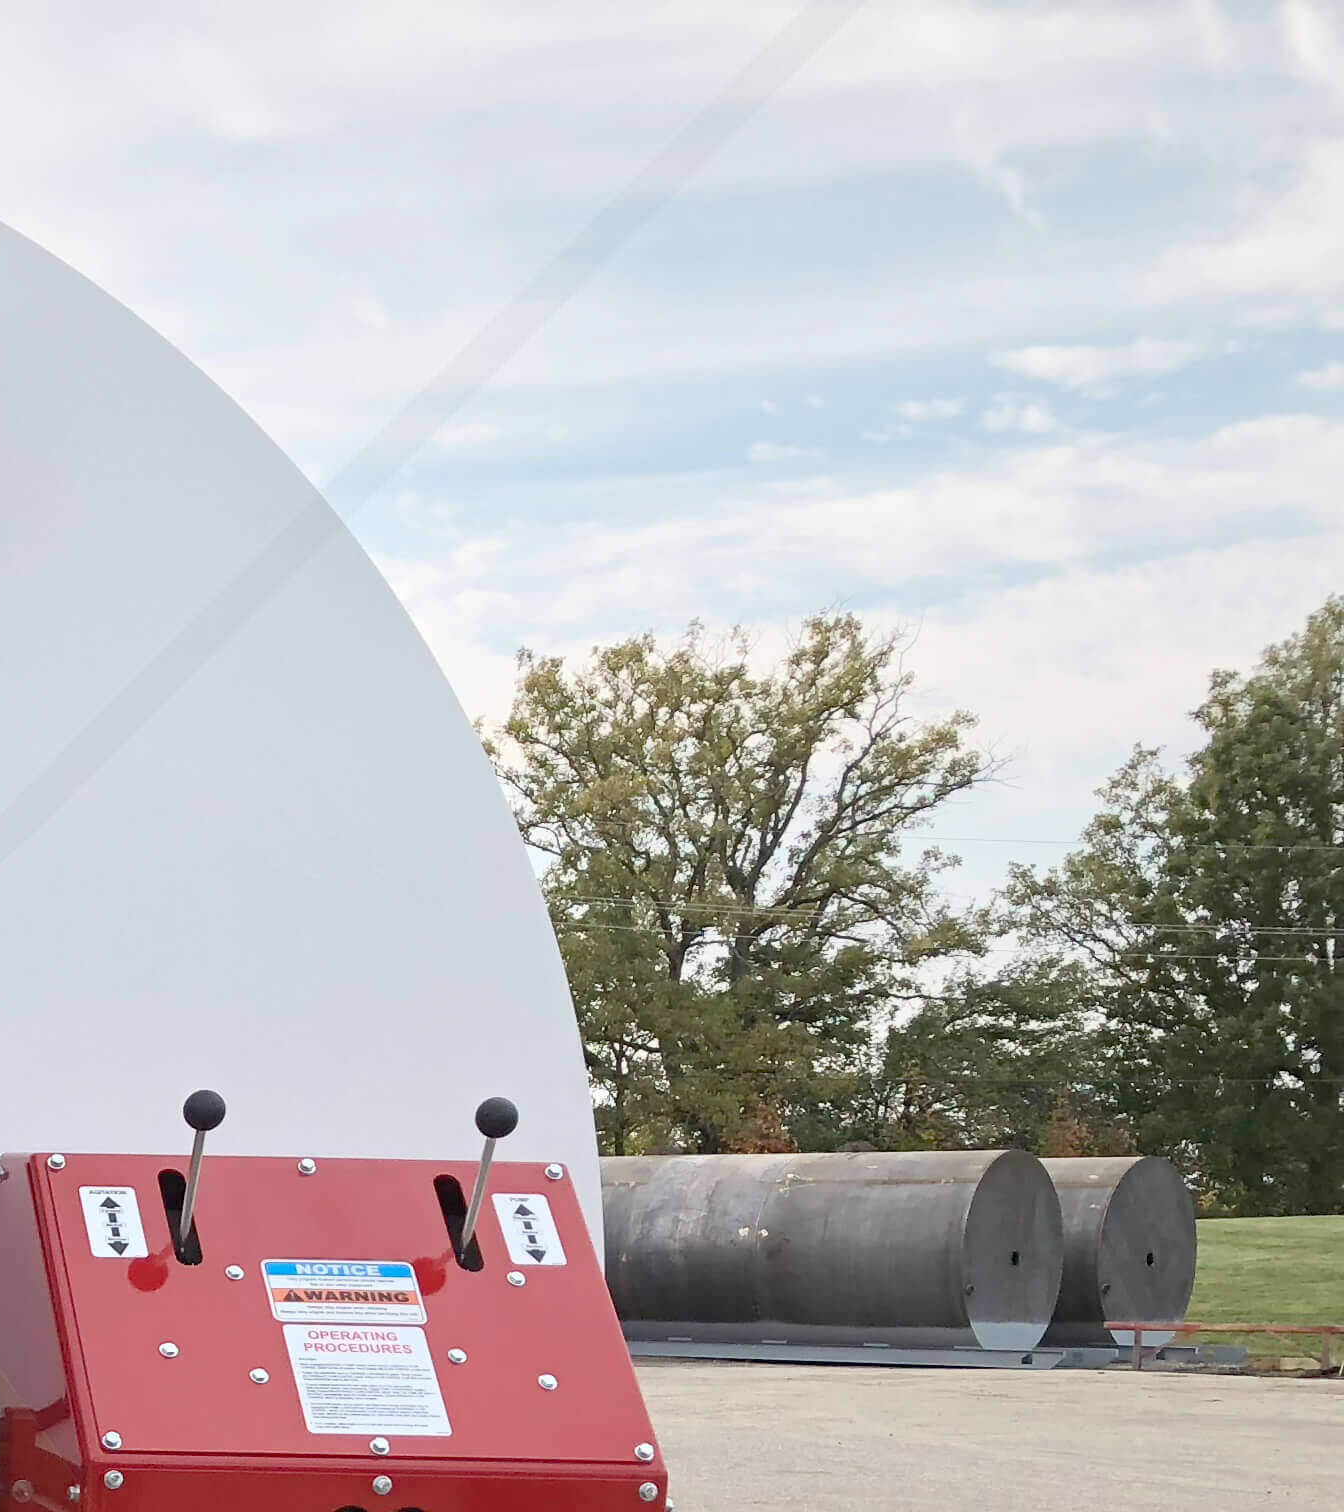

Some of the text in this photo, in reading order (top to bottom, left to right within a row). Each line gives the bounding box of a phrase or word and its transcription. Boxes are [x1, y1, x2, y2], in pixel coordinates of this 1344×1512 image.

[296, 1264, 382, 1276] NOTICE
[303, 1290, 410, 1303] WARNING
[307, 1330, 399, 1342] OPERATING
[303, 1342, 413, 1354] PROCEDURES
